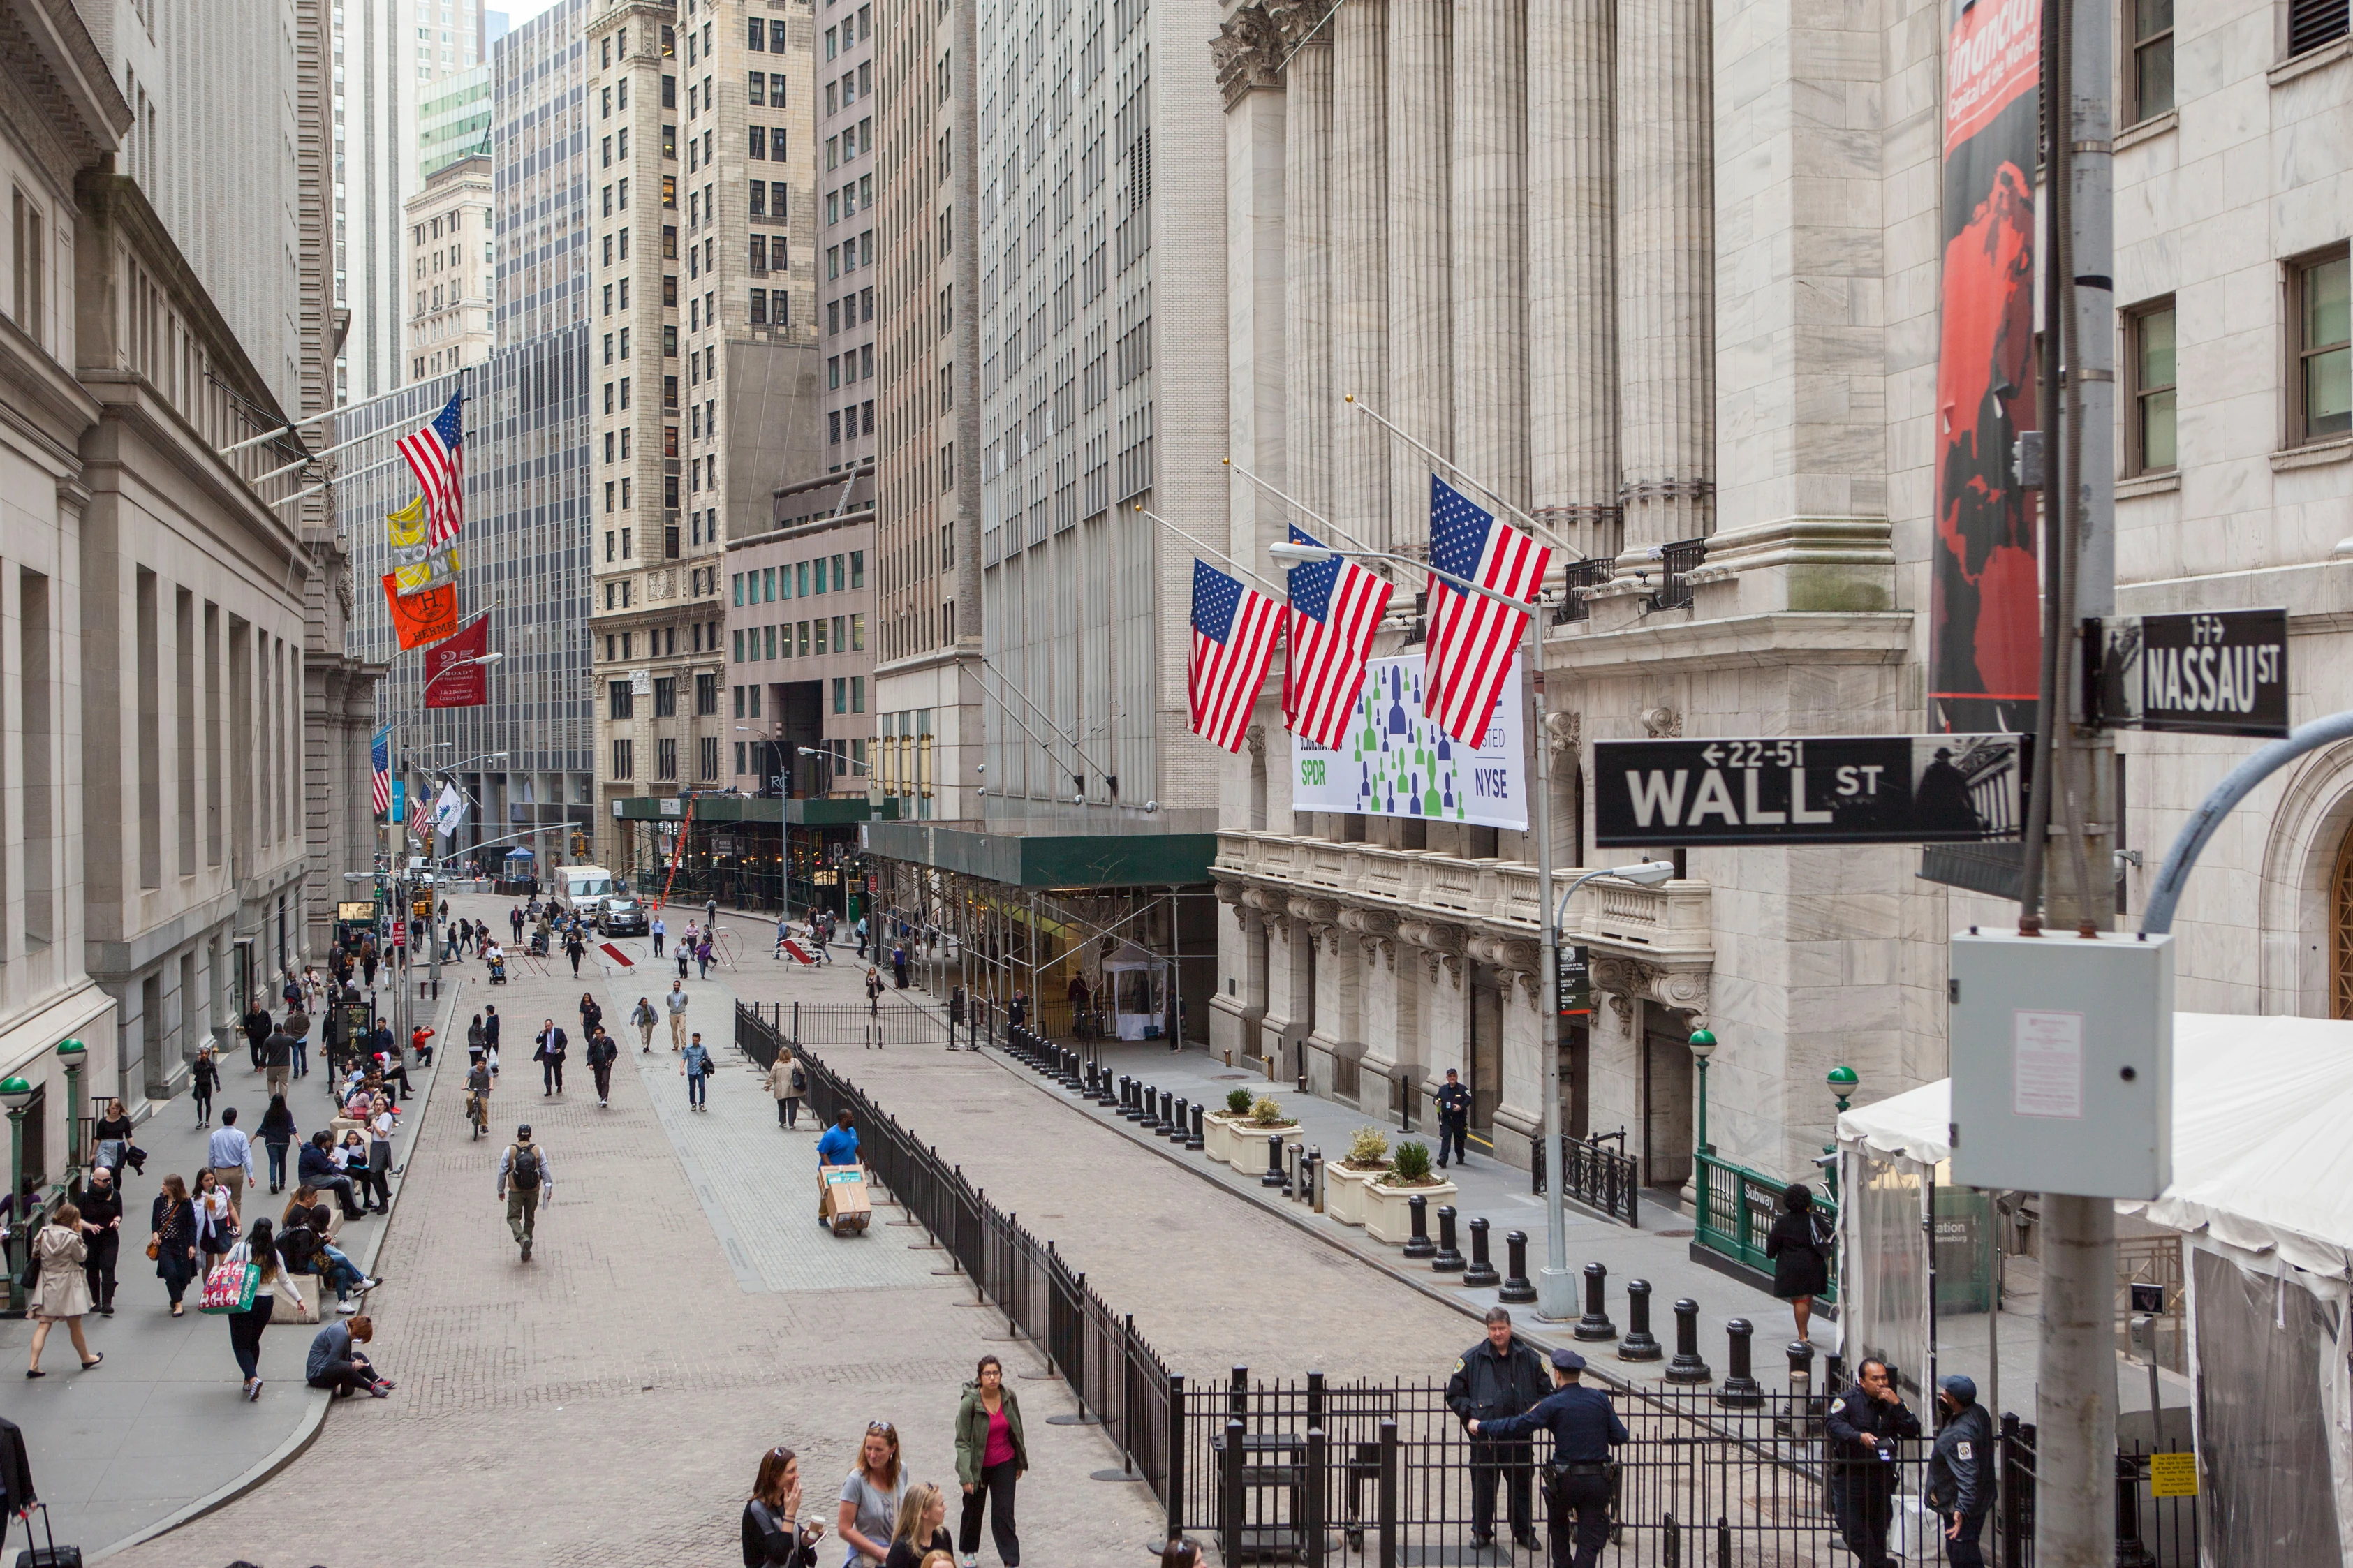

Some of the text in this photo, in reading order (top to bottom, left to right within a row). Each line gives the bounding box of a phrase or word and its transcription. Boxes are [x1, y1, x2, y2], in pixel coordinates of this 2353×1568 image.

[440, 649, 474, 667] 25
[2147, 644, 2280, 713] NASSAU ST
[1482, 728, 1505, 748] STED
[1728, 741, 1804, 767] 22-51
[1301, 759, 1326, 786] SPDR
[1475, 768, 1507, 799] NYSE
[1625, 766, 1884, 827] WALL ST
[1935, 1222, 1965, 1233] ation
